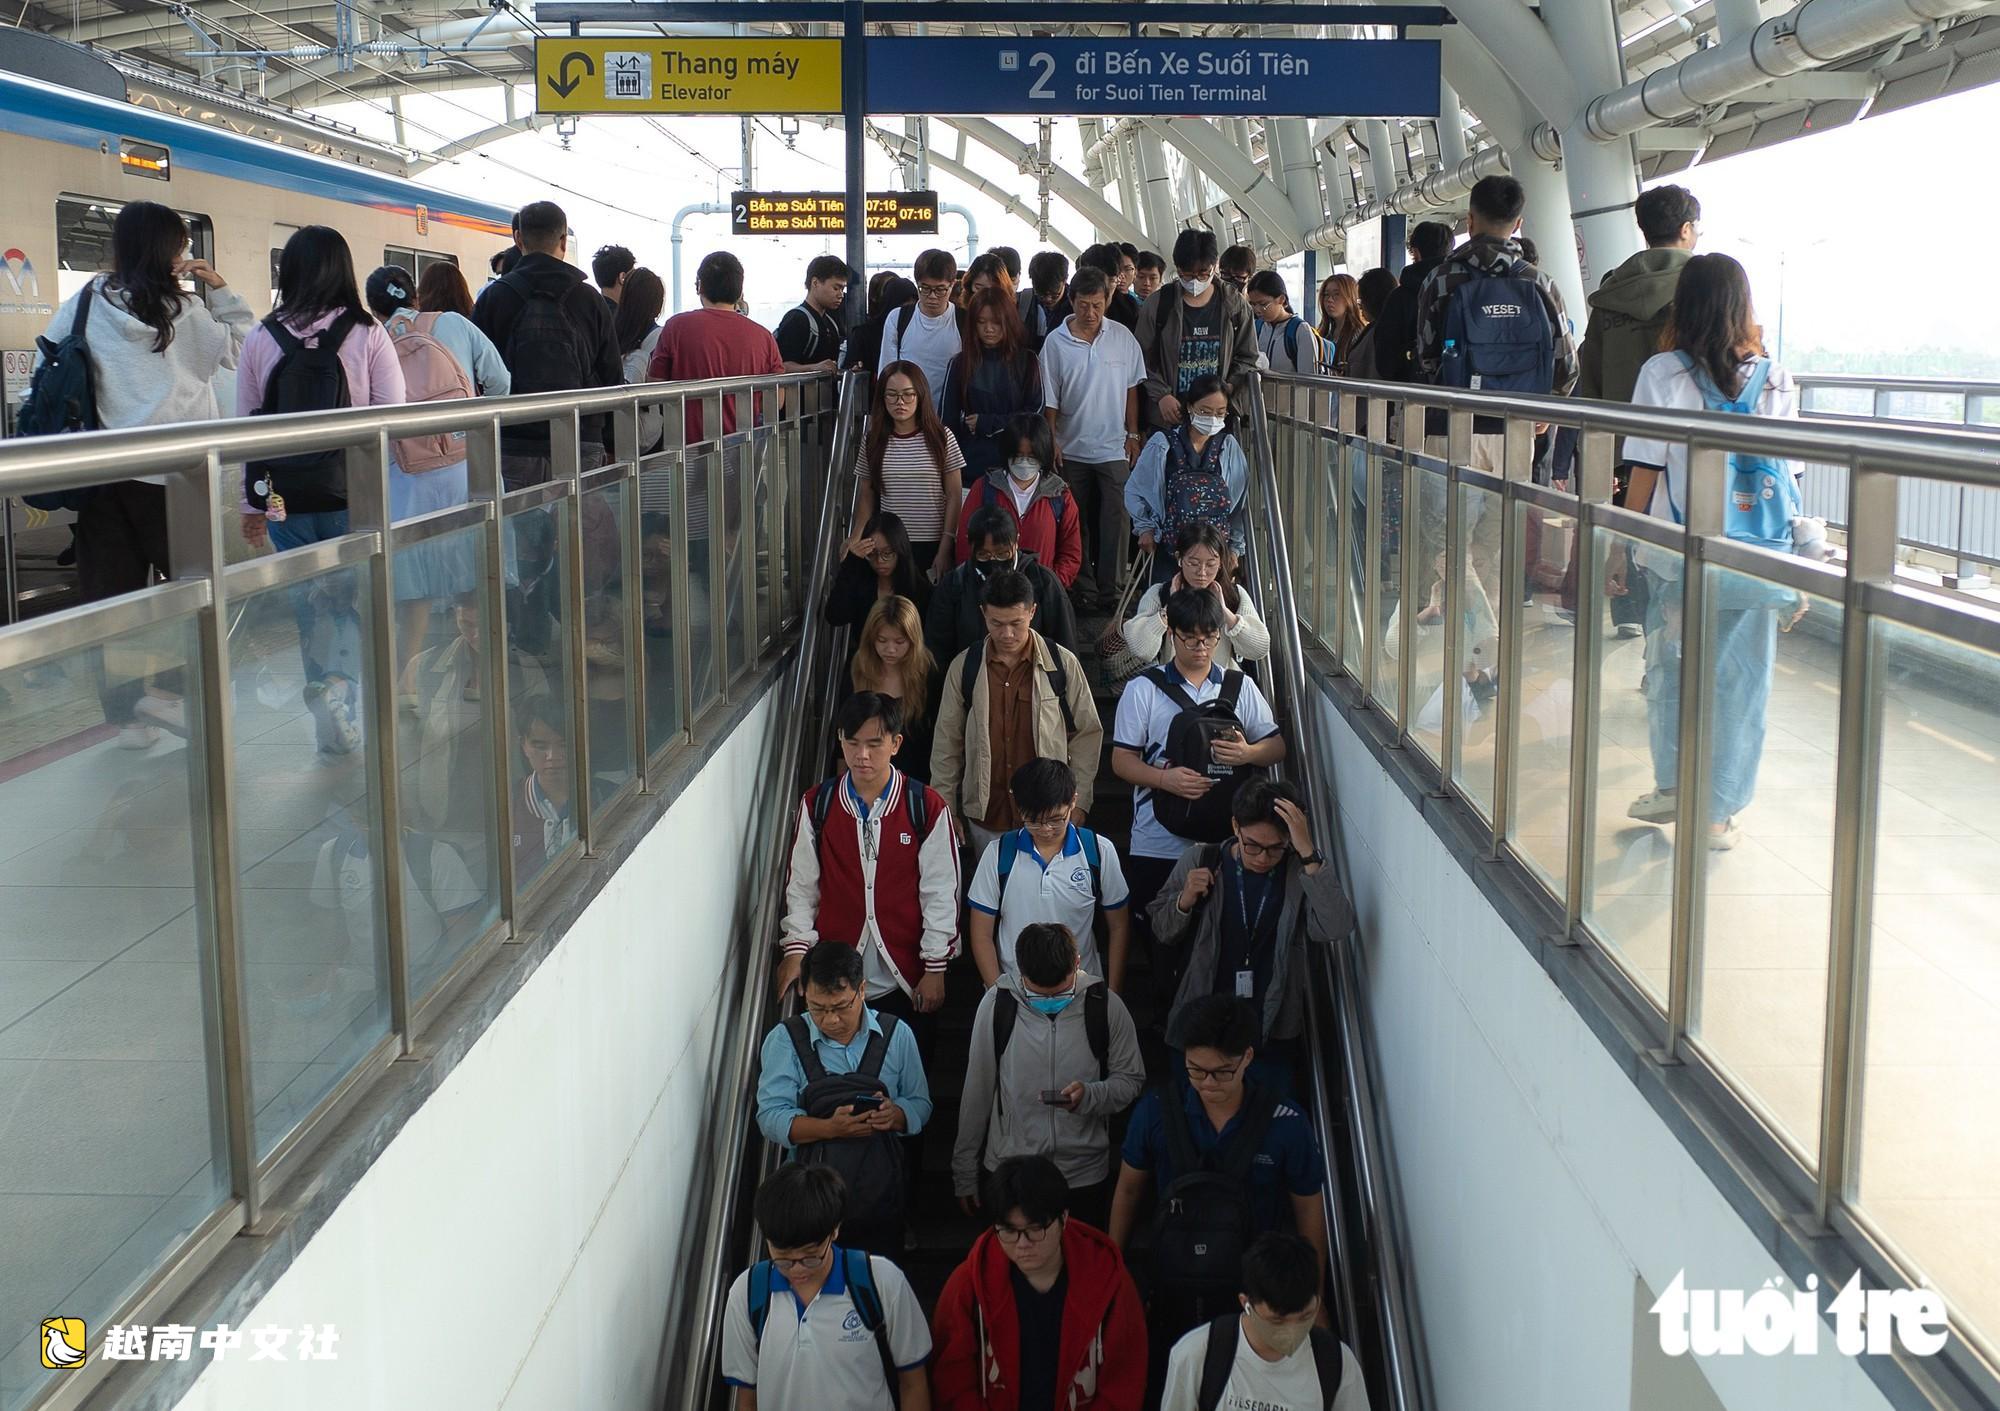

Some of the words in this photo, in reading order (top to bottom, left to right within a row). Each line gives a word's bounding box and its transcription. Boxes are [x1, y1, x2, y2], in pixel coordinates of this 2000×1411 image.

[661, 51, 737, 80] Thang
[747, 51, 800, 80] máy
[1076, 51, 1096, 74] đi
[1105, 49, 1152, 75] Bến
[1160, 52, 1190, 75] Xe
[1197, 49, 1251, 75] Suối
[1258, 52, 1309, 76] Tiên
[1028, 52, 1056, 99] 2
[661, 84, 732, 100] Elevator
[1076, 84, 1100, 100] for
[1105, 84, 1144, 101] Suoi
[1148, 84, 1184, 101] Tien
[1190, 84, 1267, 101] Terminal
[749, 198, 774, 212] Bến
[775, 202, 789, 212] xe
[790, 197, 817, 212] Suối
[818, 199, 844, 212] Tiên
[866, 199, 897, 212] 07:16
[735, 204, 748, 223] 2
[750, 214, 774, 229] Bến
[775, 219, 789, 229] xe
[791, 214, 817, 229] Suối
[818, 216, 845, 229] Tiên
[866, 216, 897, 229] 07:24
[899, 208, 932, 220] 07:16
[1481, 304, 1521, 315] WESET
